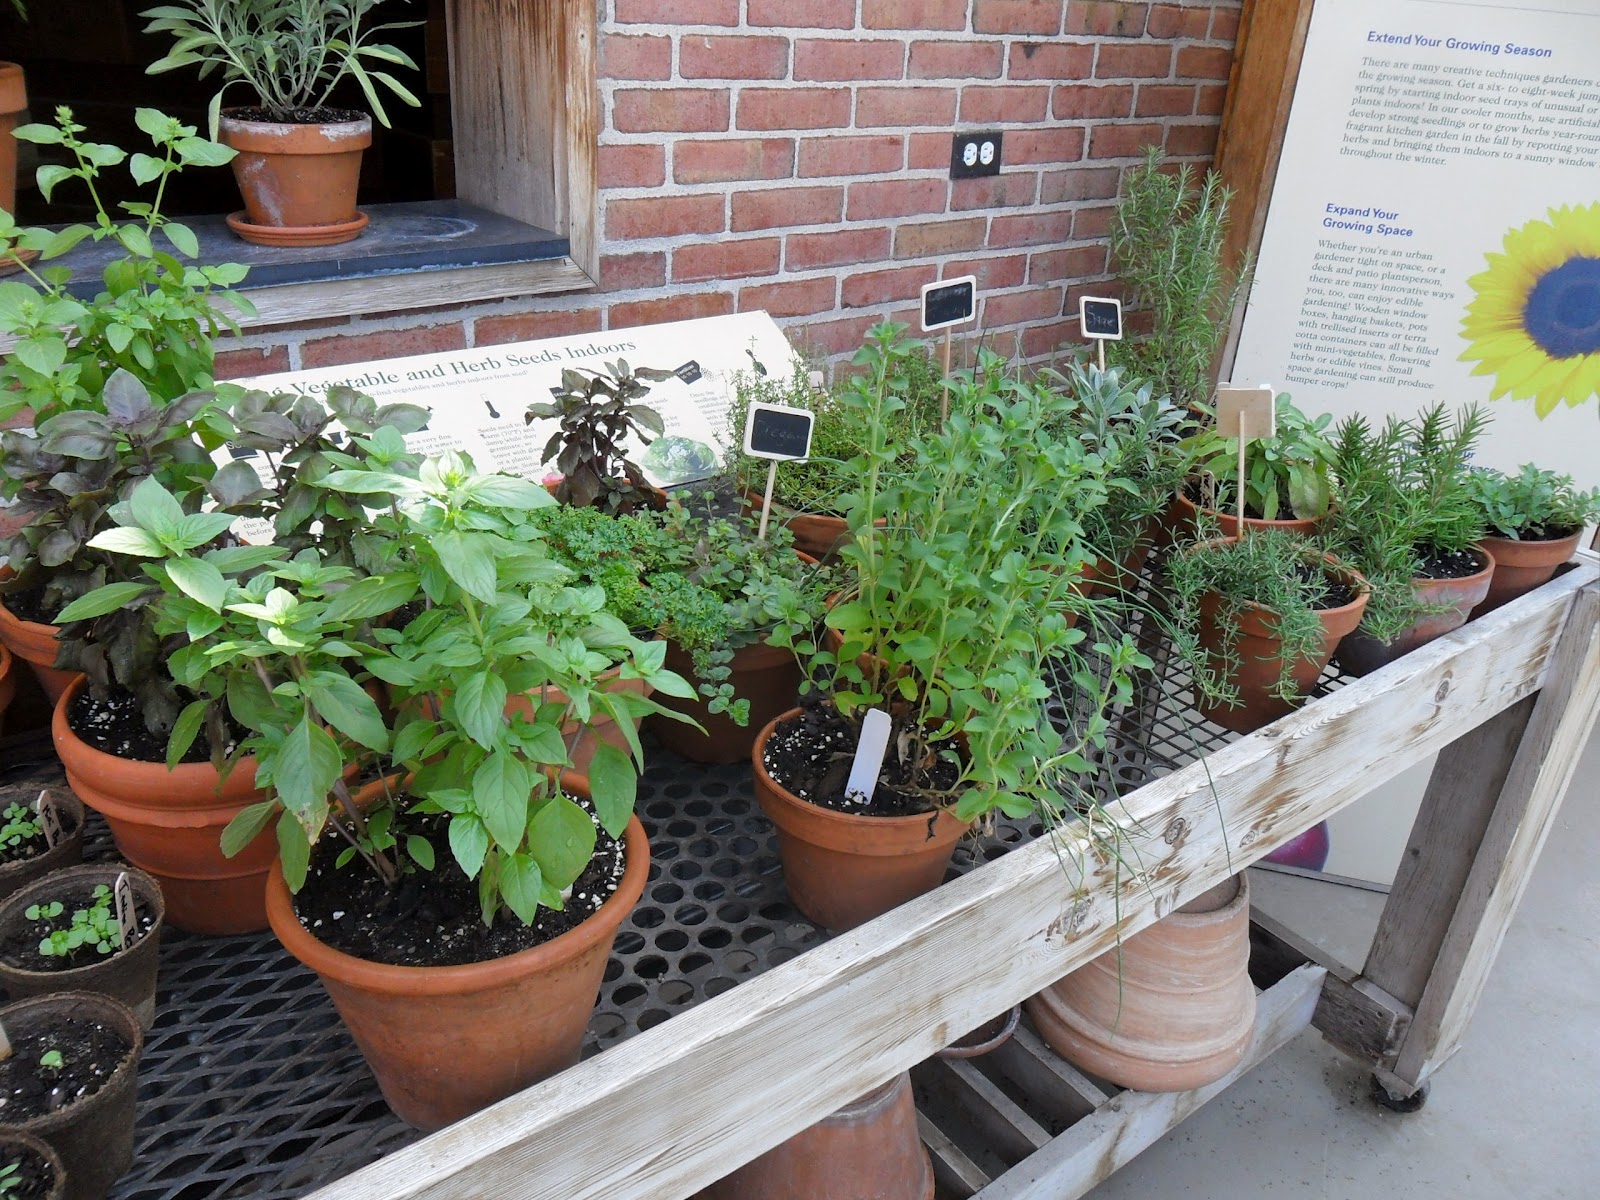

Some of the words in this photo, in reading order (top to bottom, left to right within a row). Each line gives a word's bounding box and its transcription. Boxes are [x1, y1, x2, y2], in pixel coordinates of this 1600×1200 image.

[1368, 31, 1412, 44] Extend
[1415, 35, 1442, 47] Your
[1446, 38, 1500, 55] Growing
[1504, 43, 1552, 57] Season
[1362, 57, 1390, 67] There
[1412, 64, 1440, 73] many
[1443, 67, 1482, 76] creative
[1485, 69, 1540, 82] techniques
[1542, 75, 1593, 86] gardeners
[1359, 70, 1374, 79] the
[1376, 73, 1415, 85] growing
[1418, 78, 1453, 86] season.
[1457, 79, 1475, 89] Get
[1486, 83, 1504, 92] six-
[1521, 86, 1575, 98] eight-week
[1352, 96, 1381, 106] plants
[1384, 99, 1425, 110] indoors!
[1428, 103, 1438, 112] In
[1461, 107, 1492, 117] cooler
[1494, 111, 1534, 123] months,
[1355, 85, 1385, 95] spring
[1388, 86, 1400, 96] by
[1403, 90, 1440, 100] starting
[1443, 92, 1476, 102] indoor
[1478, 96, 1501, 104] seed
[1504, 98, 1528, 109] trays
[1531, 100, 1543, 108] of
[1544, 103, 1585, 113] unusual
[1349, 108, 1386, 121] develop
[1388, 114, 1419, 125] strong
[1421, 117, 1466, 129] seedlings
[1494, 125, 1520, 133] grow
[1522, 125, 1550, 136] herbs
[1552, 131, 1600, 142] year-roun
[1346, 120, 1383, 133] fragrant
[1386, 125, 1422, 137] kitchen
[1425, 130, 1458, 140] garden
[1462, 133, 1471, 142] in
[1475, 134, 1491, 143] the
[1493, 135, 1509, 145] fall
[1512, 137, 1525, 148] by
[1526, 141, 1572, 154] repotting
[1340, 146, 1392, 159] throughout
[1396, 152, 1411, 161] the
[1415, 155, 1446, 165] winter.
[1343, 133, 1369, 144] herbs
[1372, 138, 1390, 146] and
[1393, 138, 1433, 152] bringing
[1436, 143, 1460, 153] them
[1464, 146, 1500, 157] indoors
[1524, 155, 1555, 165] sunny
[1559, 158, 1596, 167] window
[1326, 203, 1370, 217] Expand
[1373, 208, 1398, 220] Your
[1323, 218, 1373, 234] Growing
[1377, 224, 1413, 236] Space
[1319, 240, 1357, 251] Whether
[1359, 246, 1388, 255] you're
[1405, 251, 1432, 260] urban
[1314, 252, 1355, 263] gardener
[1357, 257, 1378, 266] tight
[1395, 263, 1424, 272] space,
[1312, 262, 1333, 272] deck
[1355, 270, 1379, 278] patio
[1381, 271, 1442, 287] plantsperson,
[1306, 287, 1325, 299] you,
[1328, 290, 1345, 299] too,
[1367, 295, 1393, 305] enjoy
[1395, 297, 1423, 307] edible
[1309, 274, 1333, 284] there
[1352, 281, 1379, 291] many
[1380, 283, 1429, 296] innovative
[1432, 291, 1454, 300] ways
[1301, 308, 1328, 321] boxes,
[1331, 311, 1367, 325] hanging
[1370, 316, 1405, 330] baskets,
[1303, 298, 1351, 311] gardening!
[1355, 303, 1390, 315] Wooden
[1393, 309, 1427, 319] window
[1299, 320, 1318, 328] with
[1321, 323, 1357, 333] trellised
[1359, 328, 1389, 338] inserts
[1404, 334, 1426, 342] terra
[1294, 342, 1312, 350] with
[1314, 345, 1386, 361] mini-vegetables,
[1388, 353, 1430, 367] flowering
[1320, 335, 1367, 346] containers
[1402, 344, 1413, 352] be
[1416, 345, 1439, 355] filled
[406, 364, 446, 381] and
[450, 357, 501, 374] Herb
[506, 348, 562, 367] Seeds
[566, 339, 637, 358] Indoors
[1290, 352, 1315, 362] herbs
[1329, 358, 1356, 368] edible
[1359, 362, 1383, 371] vines.
[1387, 365, 1413, 375] Small
[392, 384, 431, 395] vegetables
[468, 376, 494, 384] indoors
[1285, 373, 1319, 385] bumper
[1321, 380, 1348, 389] crops!
[1287, 365, 1312, 373] space
[1314, 367, 1358, 380] gardening
[1378, 376, 1396, 384] still
[1397, 380, 1434, 389] produce
[246, 528, 272, 536] before
